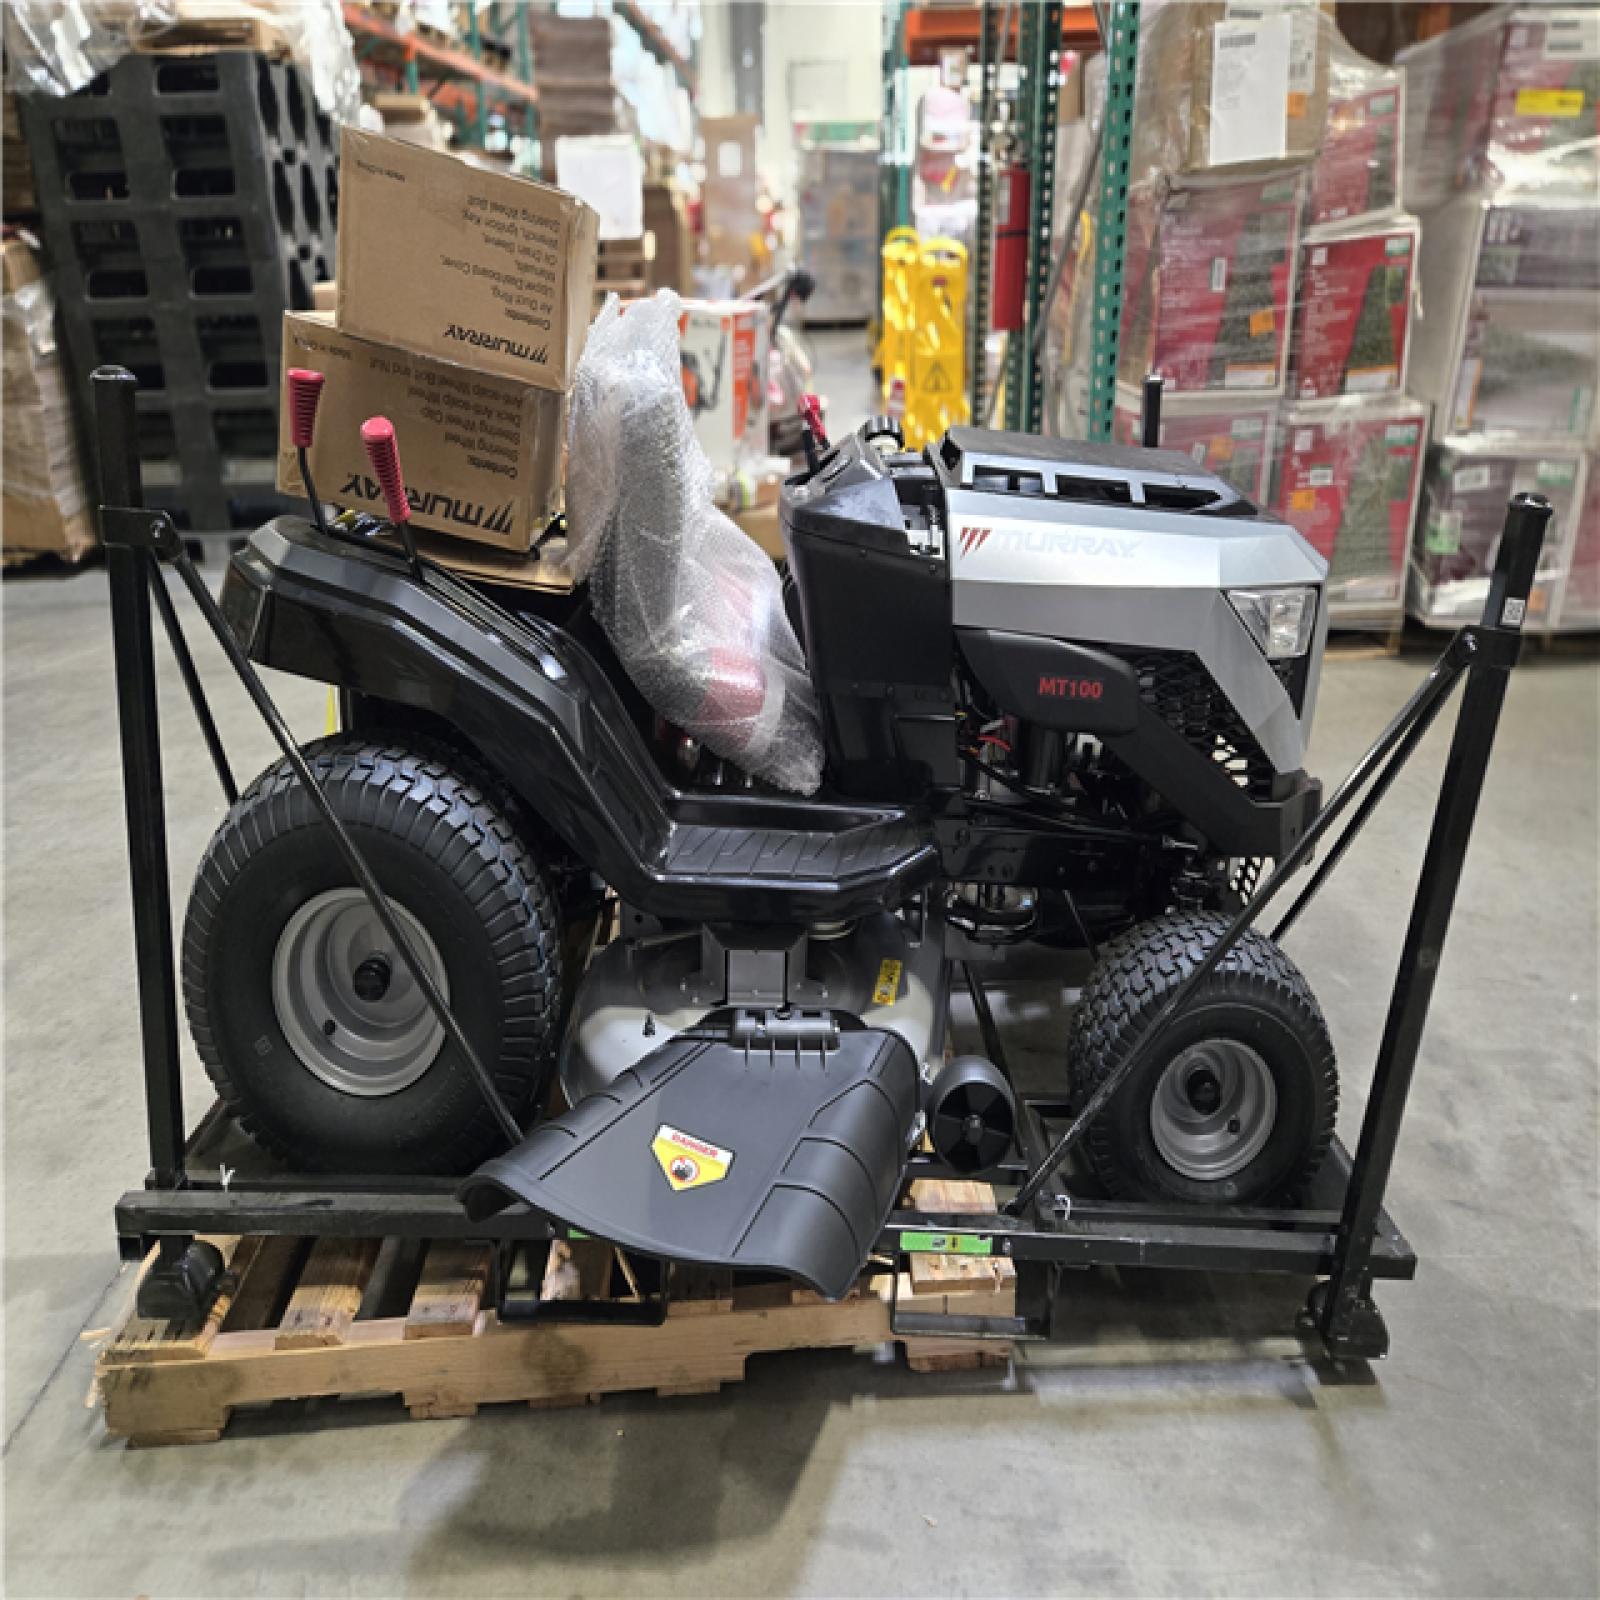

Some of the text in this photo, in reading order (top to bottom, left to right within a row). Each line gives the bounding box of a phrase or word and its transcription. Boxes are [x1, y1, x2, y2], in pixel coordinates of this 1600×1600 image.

[490, 203, 519, 219] Wheel
[522, 211, 560, 233] Steering
[525, 281, 555, 297] Upper
[514, 295, 538, 310] Duct
[540, 303, 553, 314] Air
[442, 324, 530, 357] MURRAY
[447, 415, 477, 432] Wheel
[480, 421, 520, 445] Steering
[444, 433, 520, 462] Steering Wheel
[467, 457, 518, 480] Contents:
[341, 474, 484, 526] MURAY
[999, 530, 1142, 558] MURRAY
[1039, 677, 1103, 698] MT100
